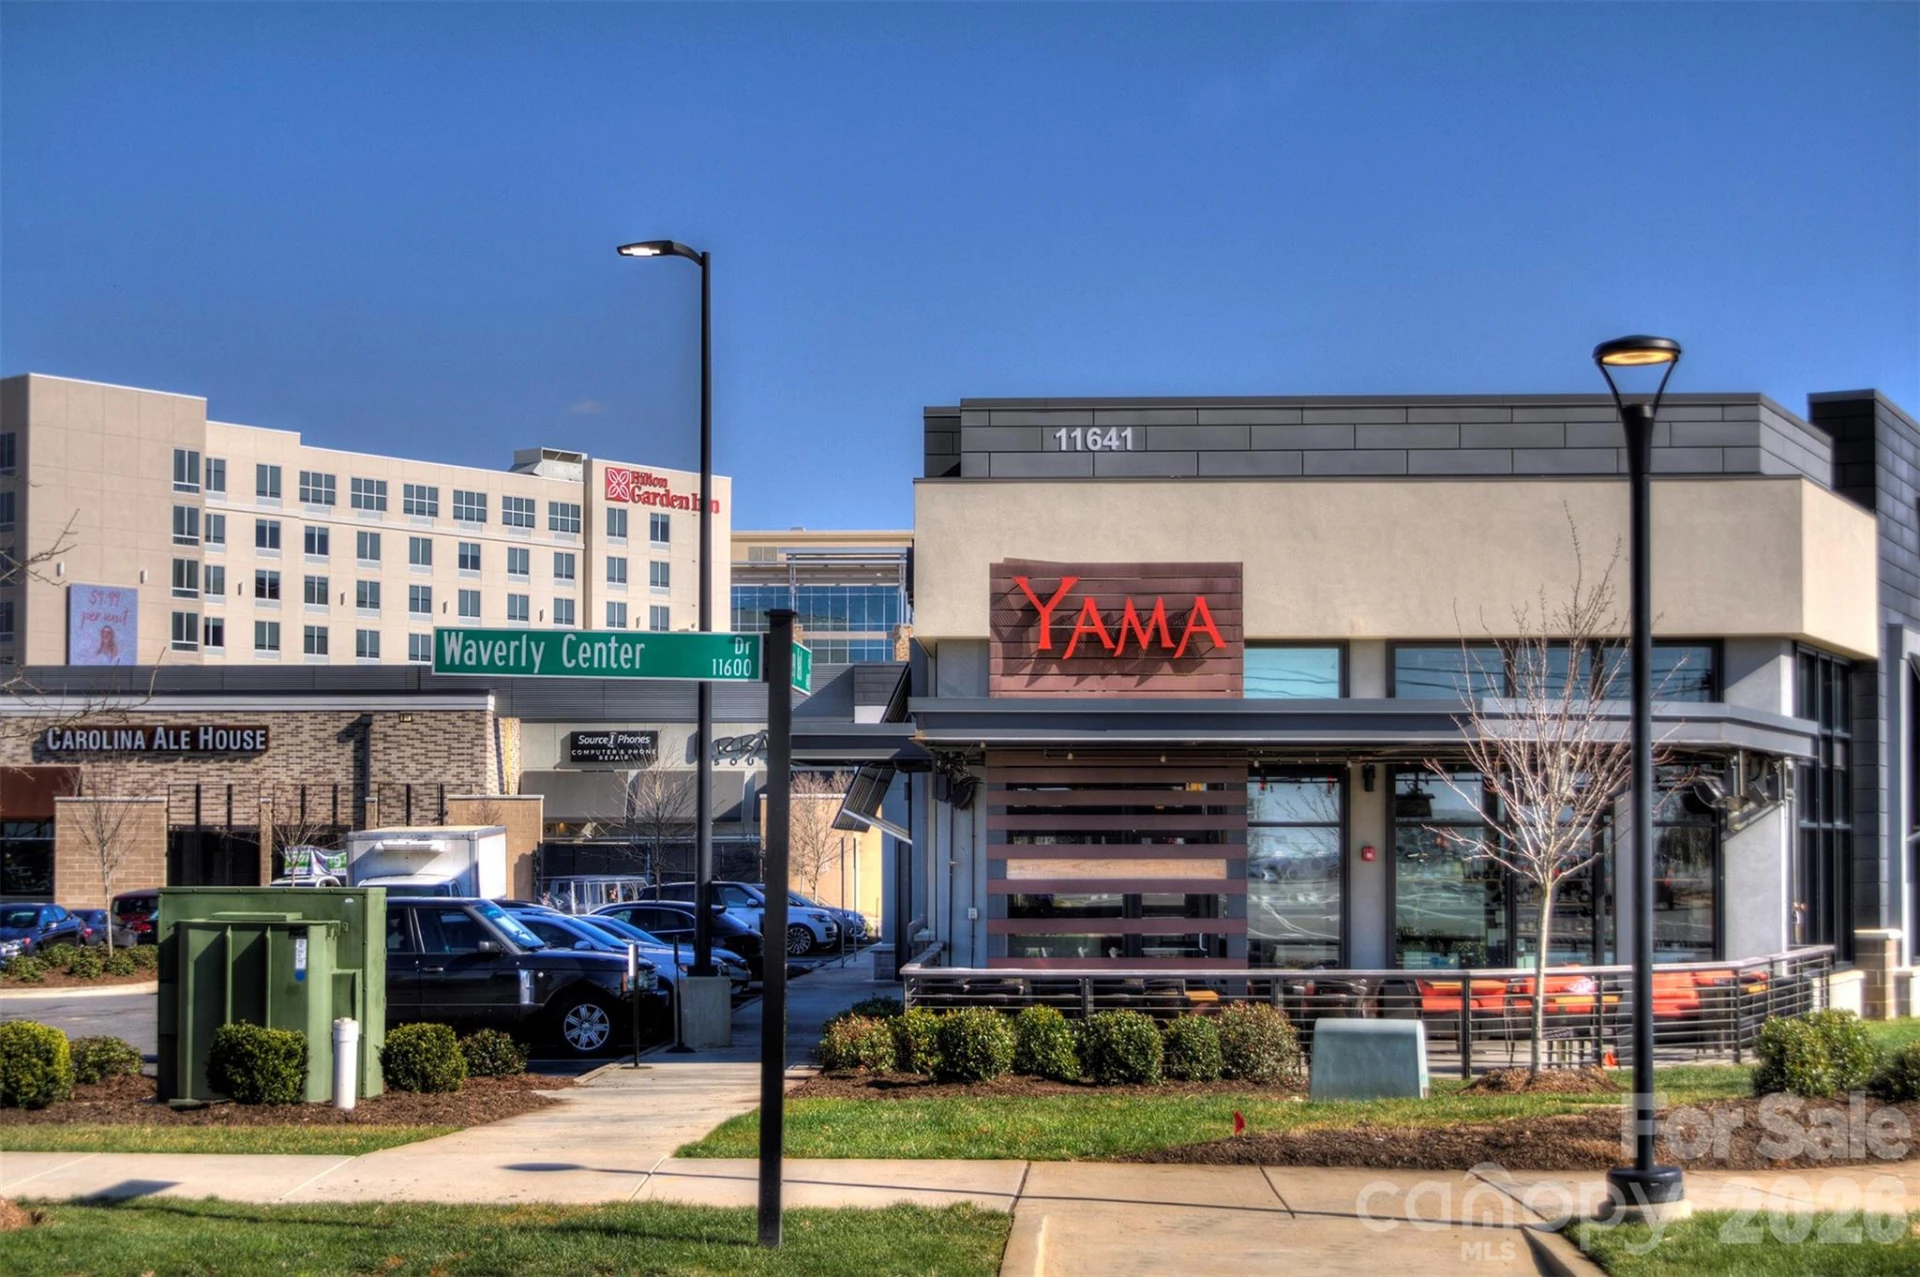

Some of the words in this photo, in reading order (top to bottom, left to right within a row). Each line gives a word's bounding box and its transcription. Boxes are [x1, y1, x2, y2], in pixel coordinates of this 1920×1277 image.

[1055, 427, 1133, 451] 11641
[631, 471, 668, 488] Hilton
[630, 486, 690, 510] Garden
[691, 493, 719, 513] In
[1012, 576, 1227, 660] YAMA
[443, 631, 547, 673] Waverly
[562, 633, 646, 669] Center
[734, 637, 752, 655] Dr
[712, 658, 752, 677] 11600
[47, 727, 146, 750] CAROLINA
[153, 726, 191, 750] ALE
[199, 726, 267, 750] HOUSE
[578, 735, 608, 744] Source
[617, 734, 651, 744] Phones
